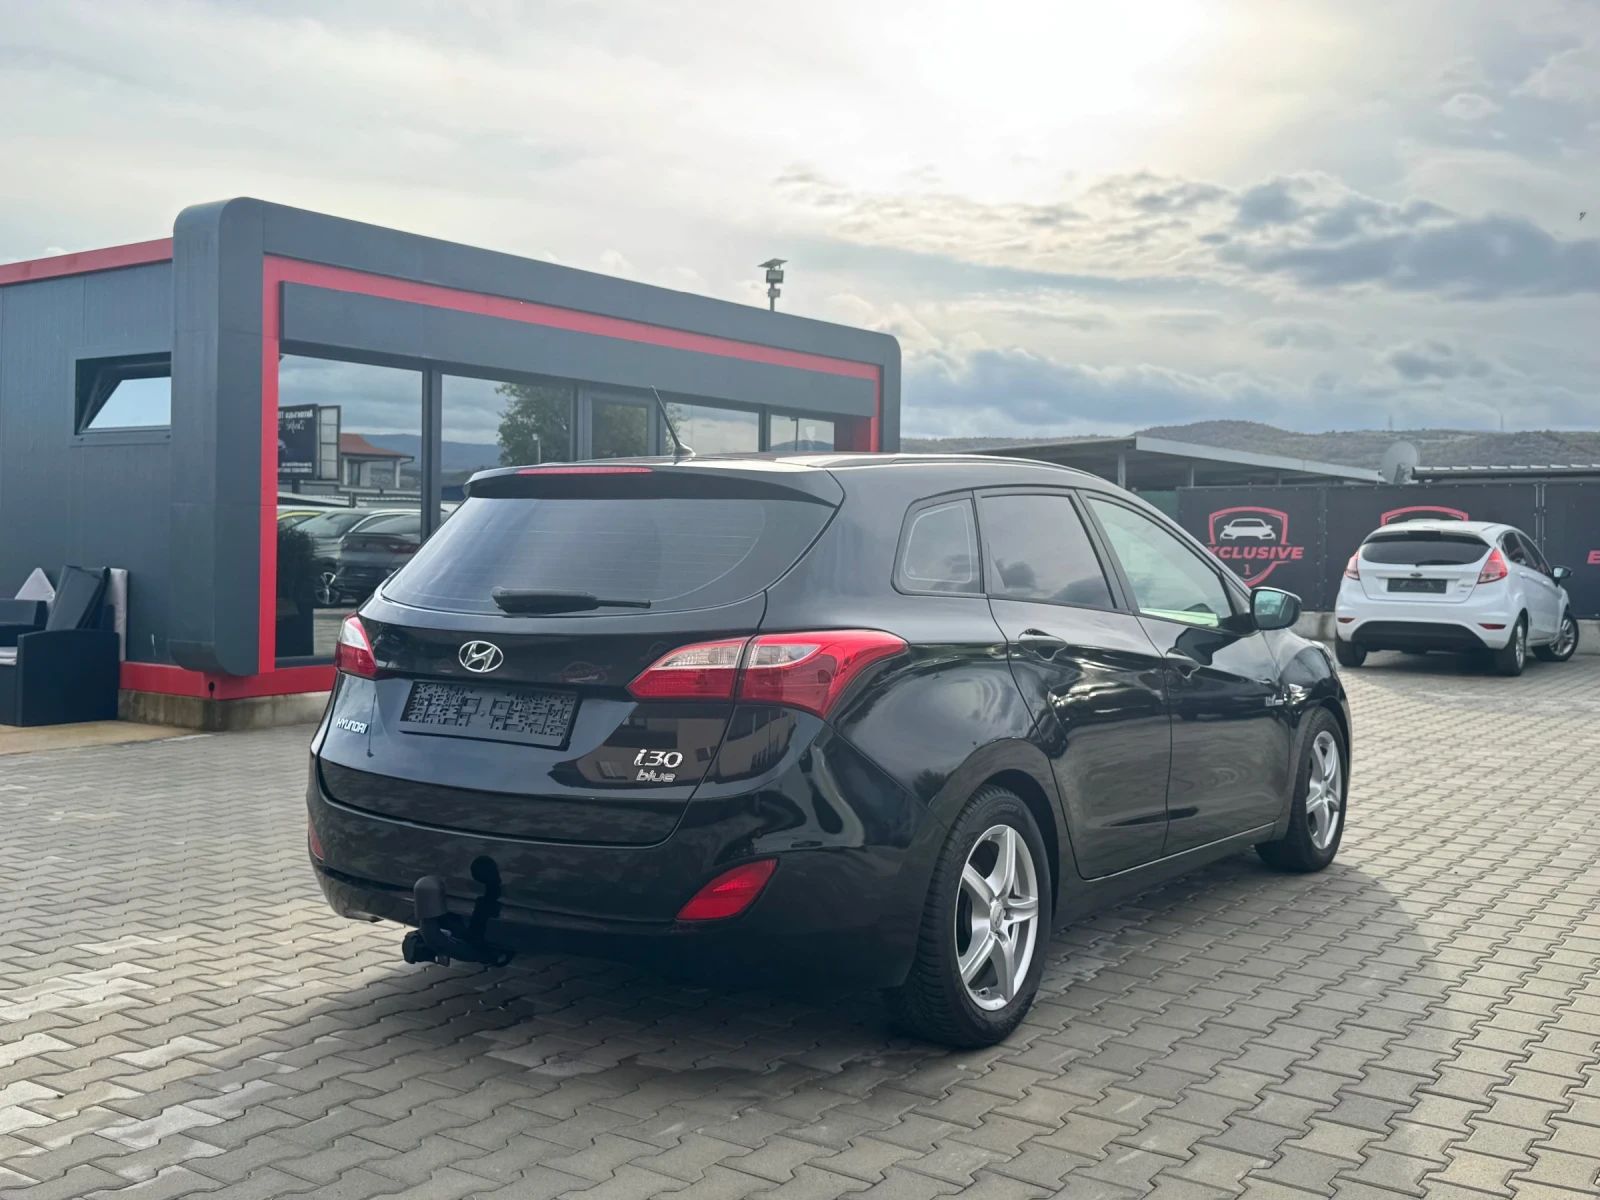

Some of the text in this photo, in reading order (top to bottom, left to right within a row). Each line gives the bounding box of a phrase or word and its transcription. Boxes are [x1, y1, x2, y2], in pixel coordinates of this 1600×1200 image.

[1207, 546, 1305, 559] XCLUSIVE
[1243, 563, 1252, 576] 1
[336, 717, 368, 734] HYUNDAI
[633, 748, 683, 769] i30
[636, 768, 676, 783] blue
